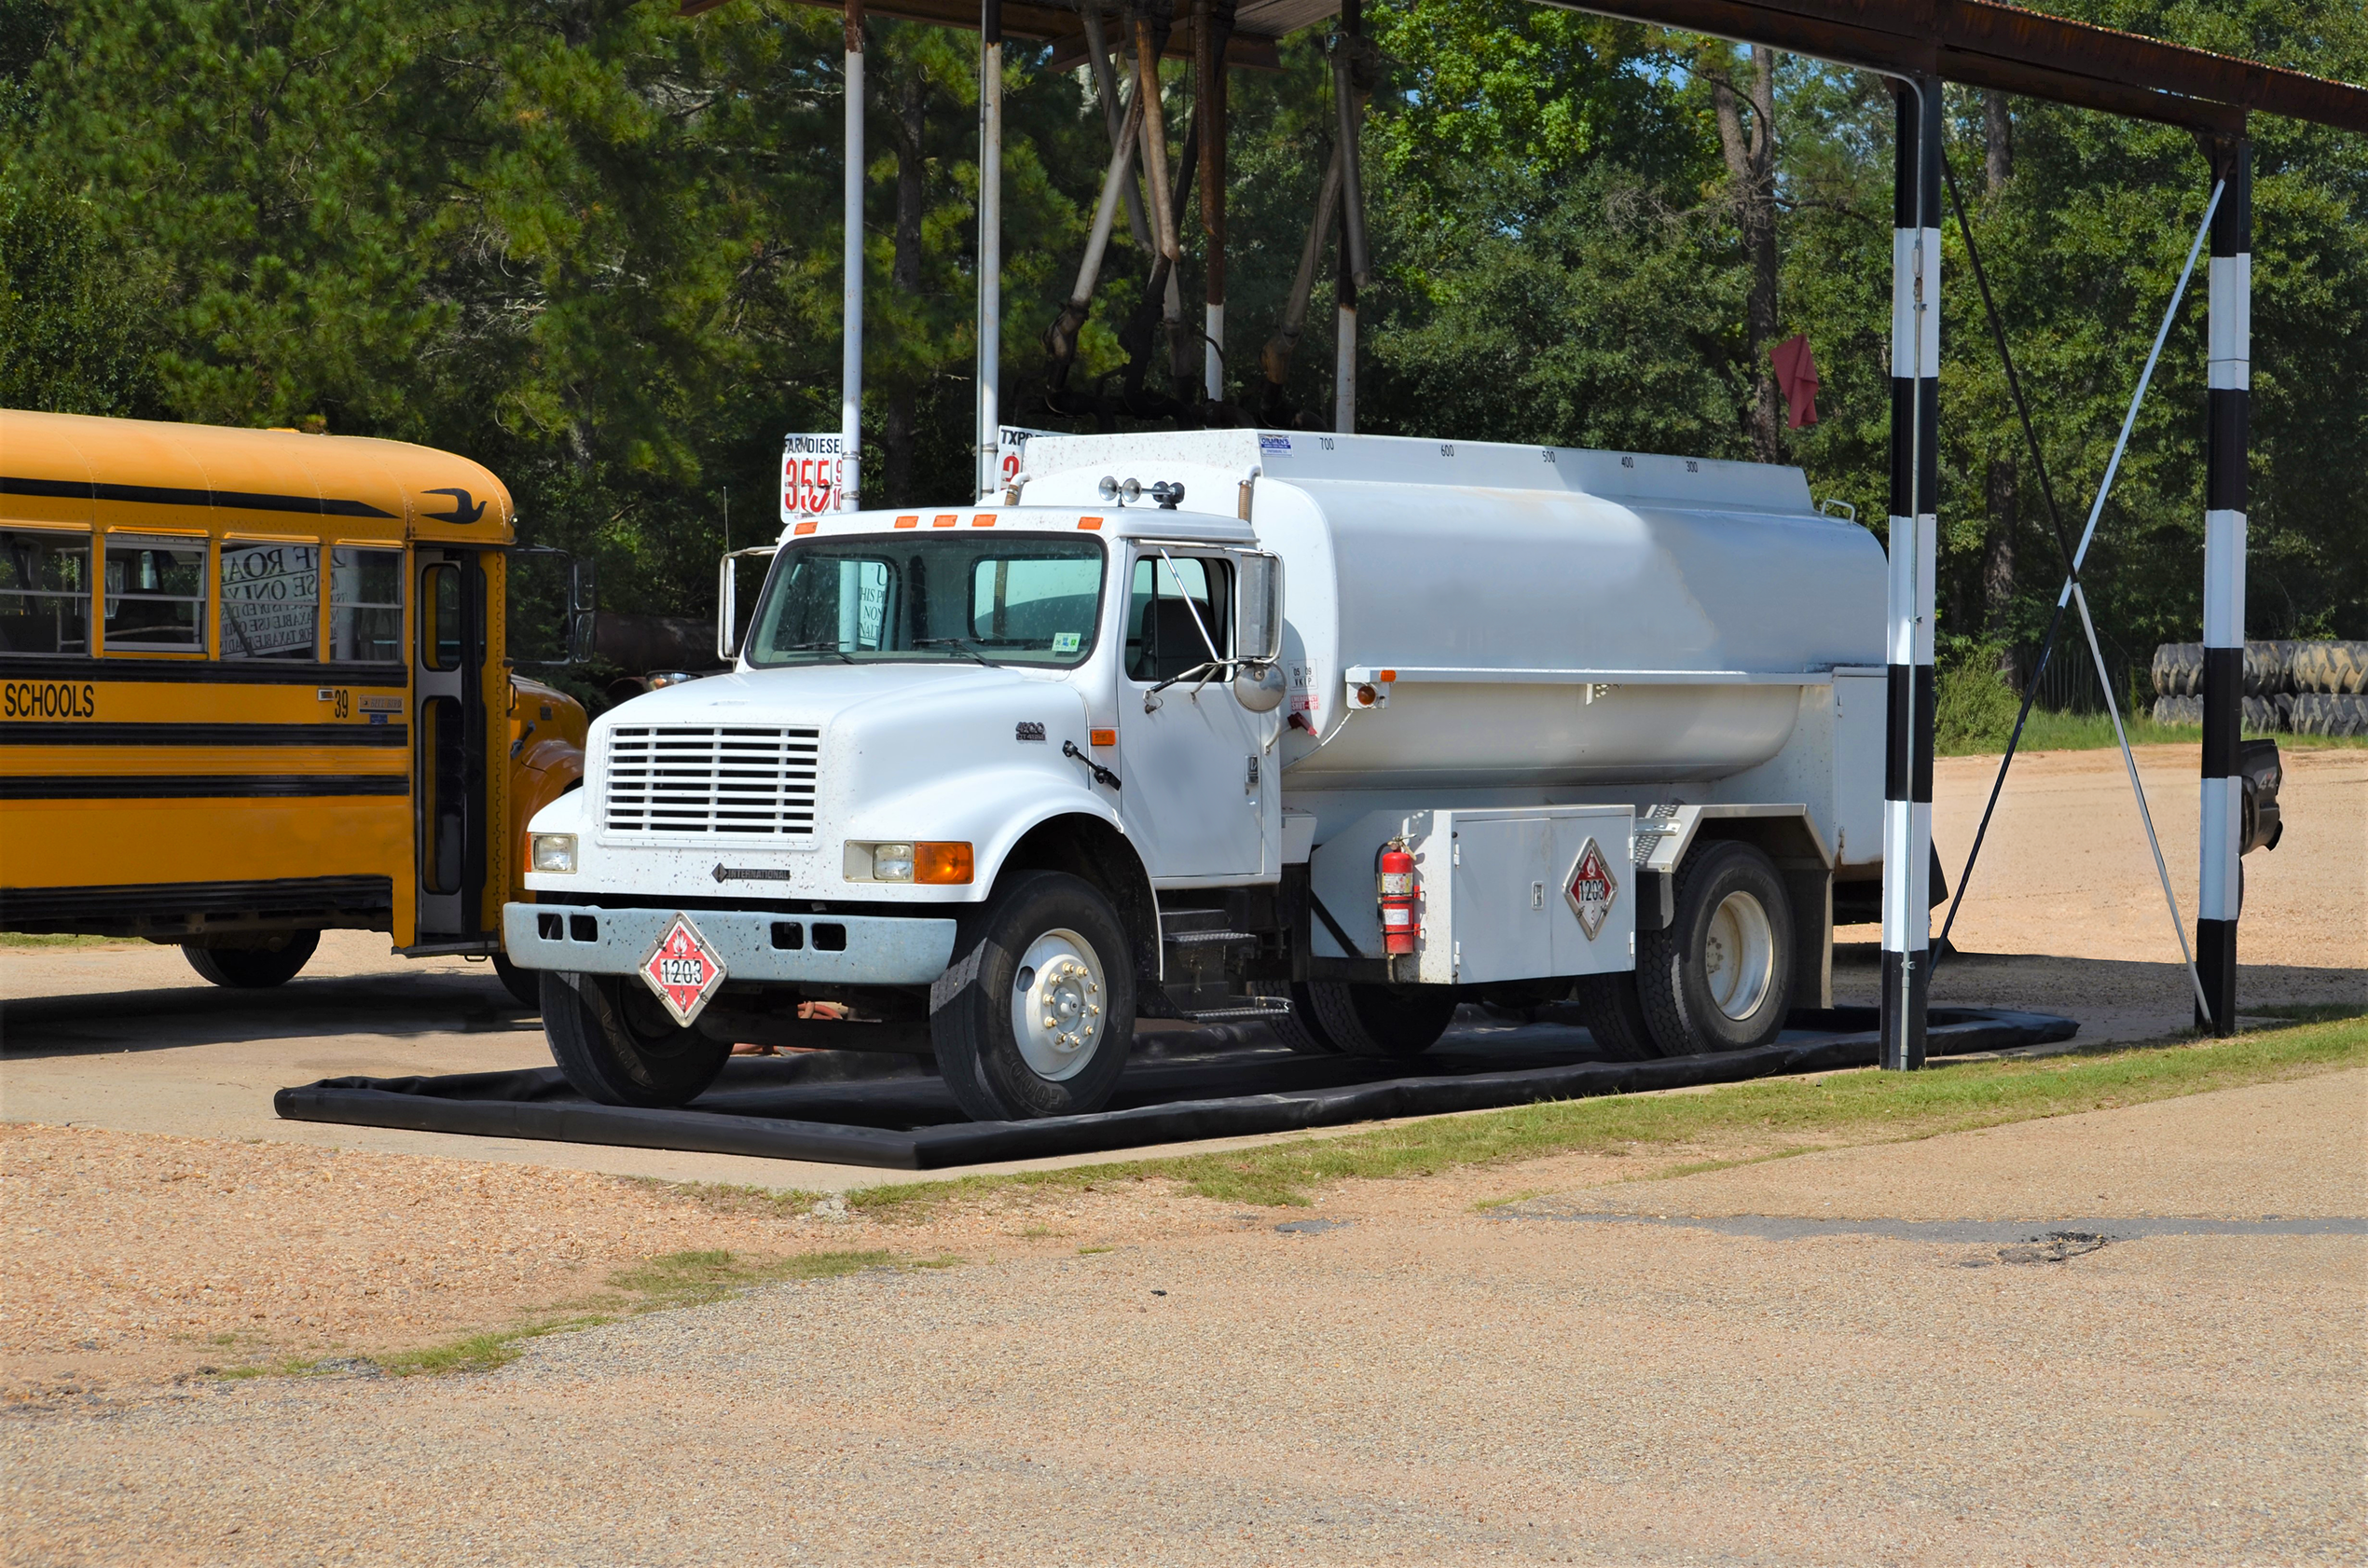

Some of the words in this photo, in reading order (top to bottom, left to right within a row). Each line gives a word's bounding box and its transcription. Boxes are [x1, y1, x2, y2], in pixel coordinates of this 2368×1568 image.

[1319, 437, 1334, 450] 700
[1440, 445, 1454, 457] 600
[1542, 451, 1556, 463] 500
[1621, 456, 1633, 468] 400
[1686, 461, 1698, 473] 300
[5, 683, 95, 718] SCHOOLS
[335, 689, 349, 719] 39
[727, 869, 789, 879] INTERNATIONAL
[1579, 880, 1604, 901] 1203
[662, 958, 703, 985] 1203
